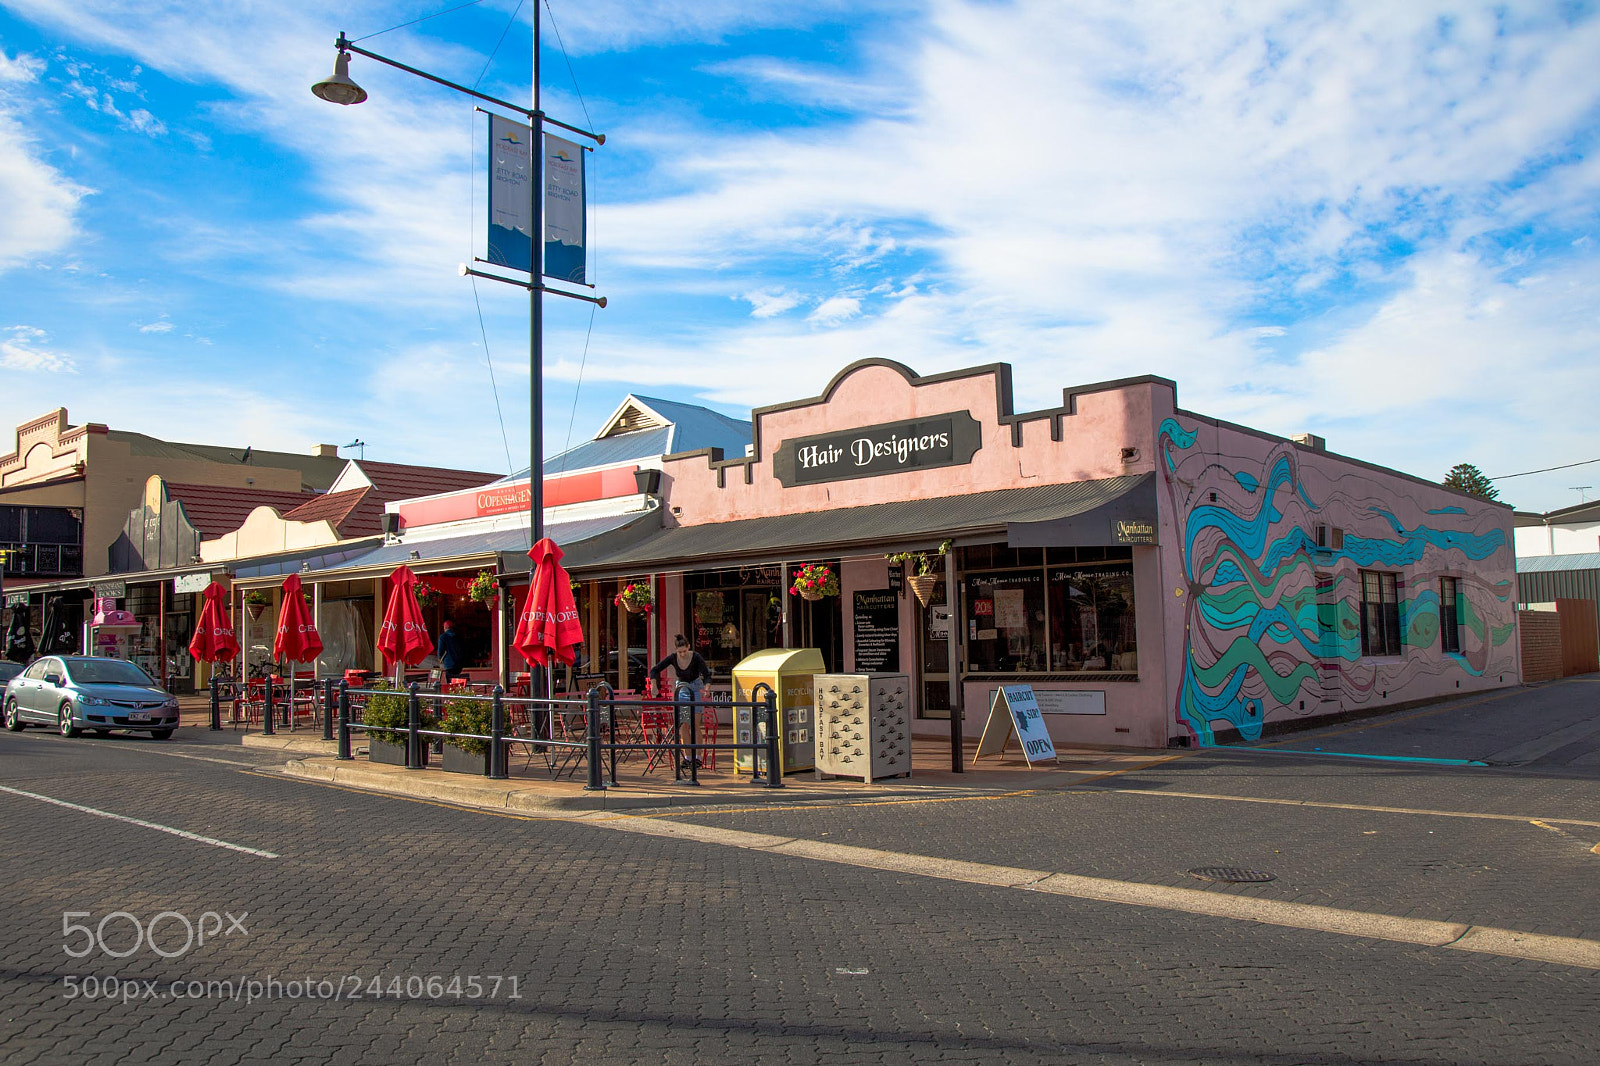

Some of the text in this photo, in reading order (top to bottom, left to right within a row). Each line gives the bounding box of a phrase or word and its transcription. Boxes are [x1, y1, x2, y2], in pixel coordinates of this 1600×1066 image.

[512, 171, 528, 182] ROAD
[563, 188, 579, 197] ROAD
[798, 432, 949, 469] Hair Designers
[1116, 520, 1153, 537] Manhattan
[856, 594, 895, 605] Manhattan
[1007, 690, 1034, 703] HAIRCUT
[1027, 739, 1052, 756] OPEN
